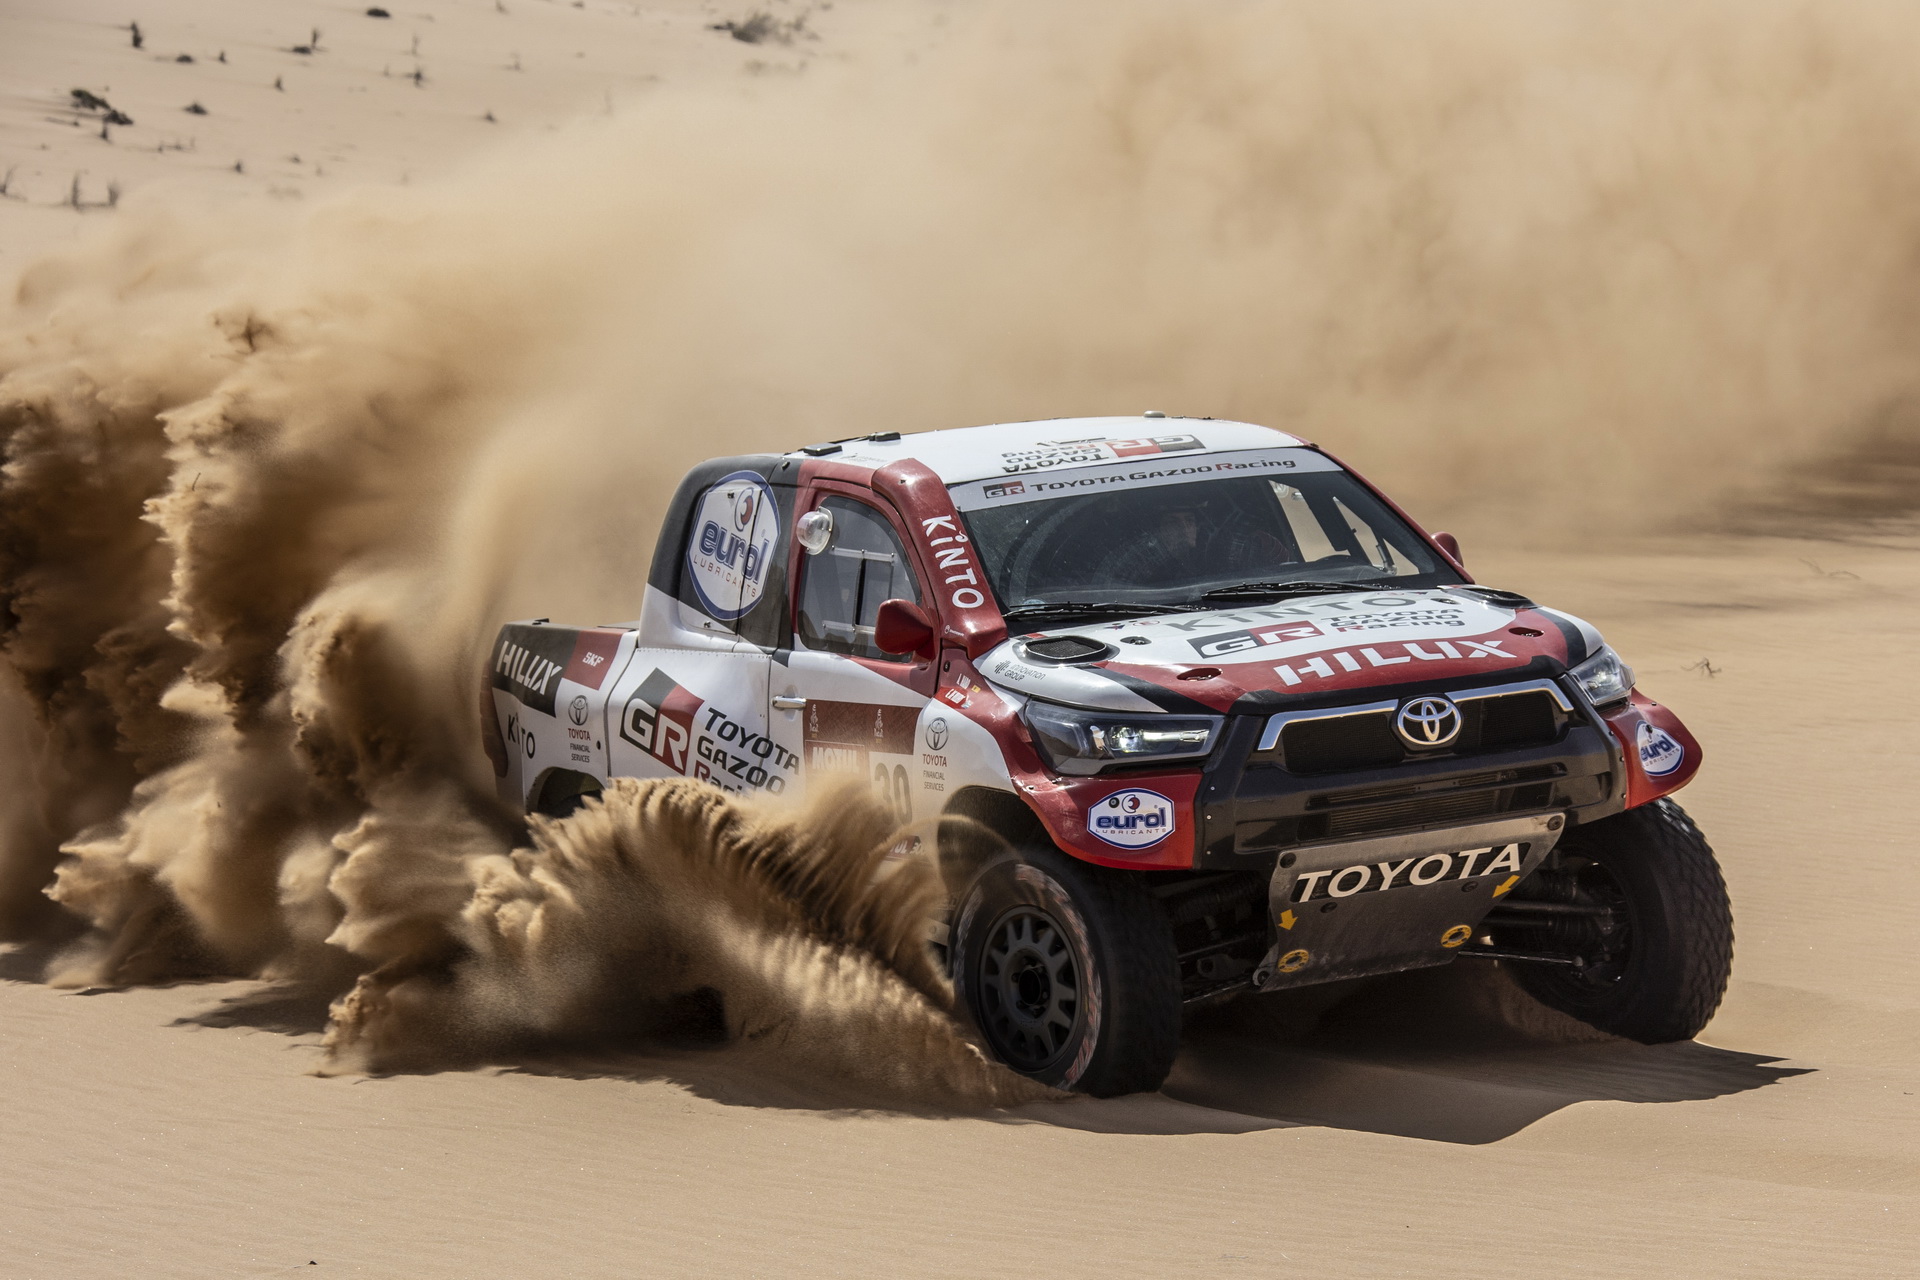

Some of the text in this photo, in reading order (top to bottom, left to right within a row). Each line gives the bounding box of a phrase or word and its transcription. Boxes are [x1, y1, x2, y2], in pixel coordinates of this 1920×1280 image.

[1002, 453, 1109, 473] TOYOTA
[1030, 459, 1296, 492] TOYOTA GAZOO Racing
[986, 483, 1025, 498] GR
[699, 520, 769, 585] eurol
[1321, 608, 1464, 622] TOYOTA
[1330, 614, 1459, 628] GAZOO
[1337, 620, 1465, 633] Racing
[1200, 626, 1322, 657] GR
[496, 640, 563, 696] HILUX
[582, 651, 604, 667] SKF
[1272, 640, 1517, 686] HILUX
[568, 728, 591, 741] TOYOTA
[623, 697, 689, 772] GR
[704, 707, 800, 776] TOYOTA
[570, 743, 590, 753] FINANCIAL
[571, 753, 590, 764] SERVICES
[697, 735, 786, 797] GAZOO
[812, 746, 860, 773] MOTUL
[922, 753, 947, 767] TOYOTA
[923, 770, 945, 781] FINANCIAL
[874, 762, 913, 829] 30
[924, 781, 945, 792] SERVICES
[1096, 806, 1167, 829] eurol
[1297, 843, 1521, 903] TOYOTA
